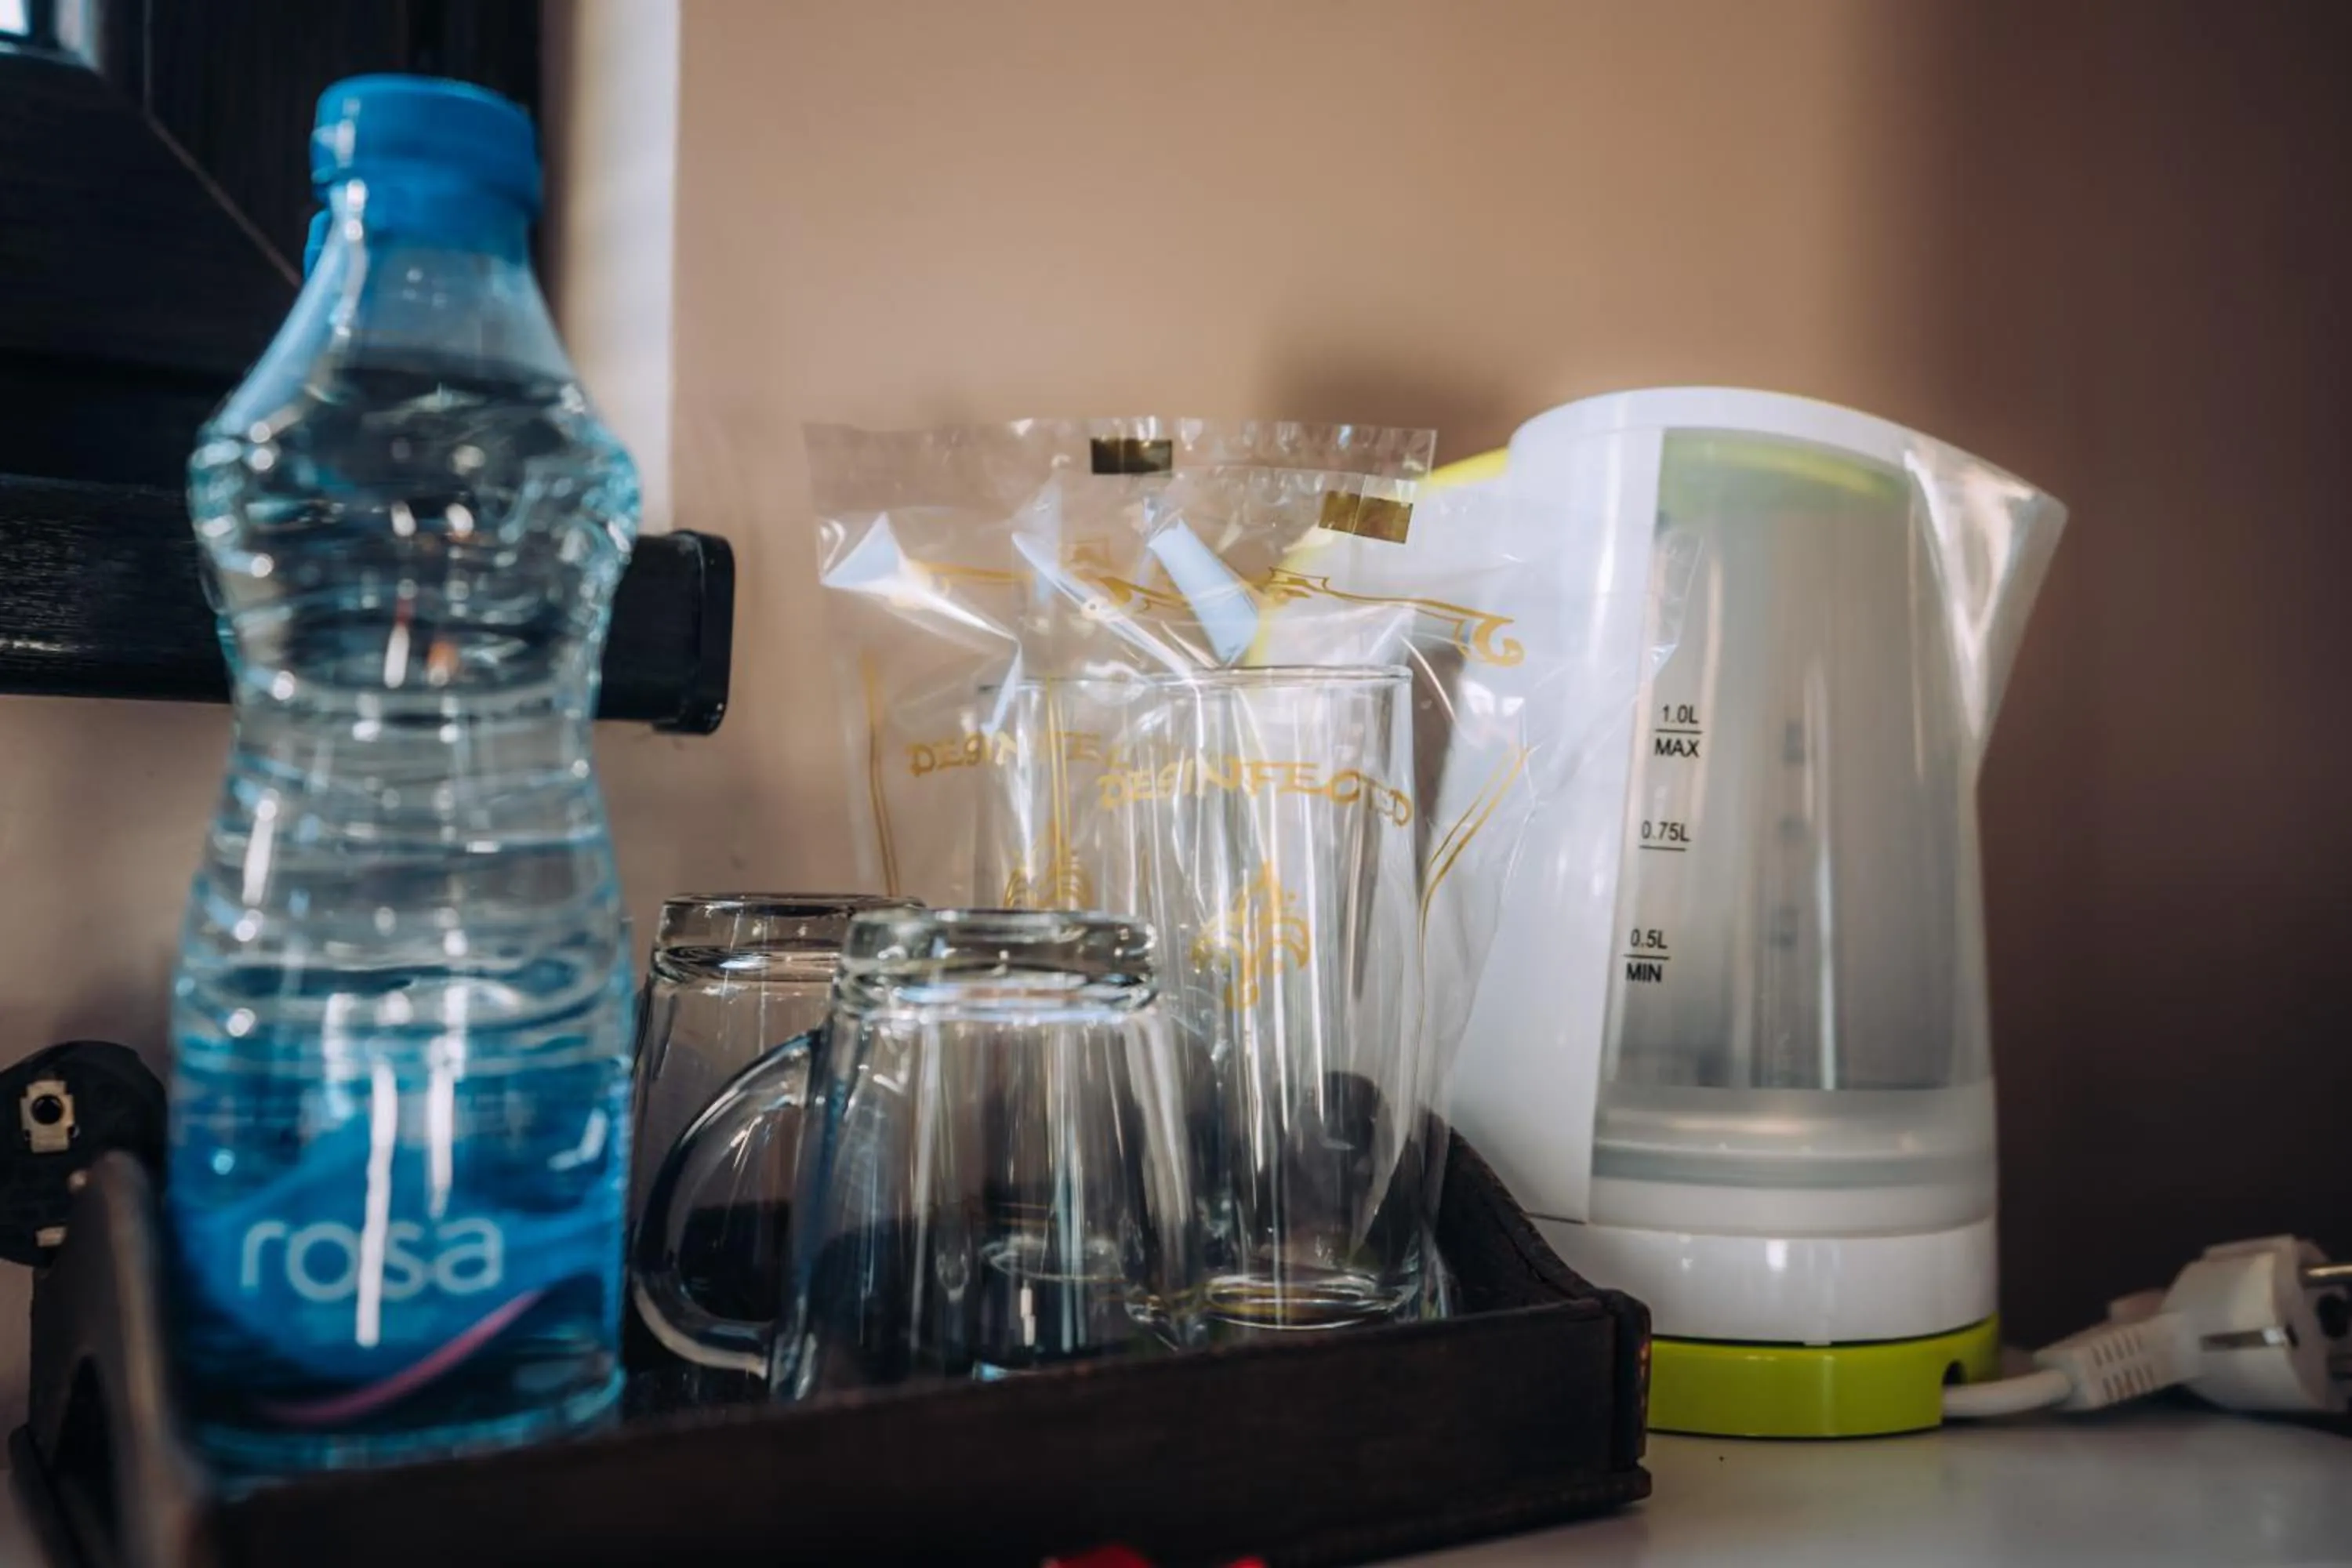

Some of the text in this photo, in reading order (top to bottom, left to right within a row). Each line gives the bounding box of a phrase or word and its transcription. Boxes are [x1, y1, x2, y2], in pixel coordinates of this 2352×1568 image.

[1661, 705, 1699, 724] 1.0L
[1654, 738, 1700, 758] MAX
[1642, 821, 1690, 843] 0.75L
[1630, 928, 1668, 949] 0.5L
[1626, 963, 1661, 982] MIN
[241, 1217, 504, 1301] rosa
